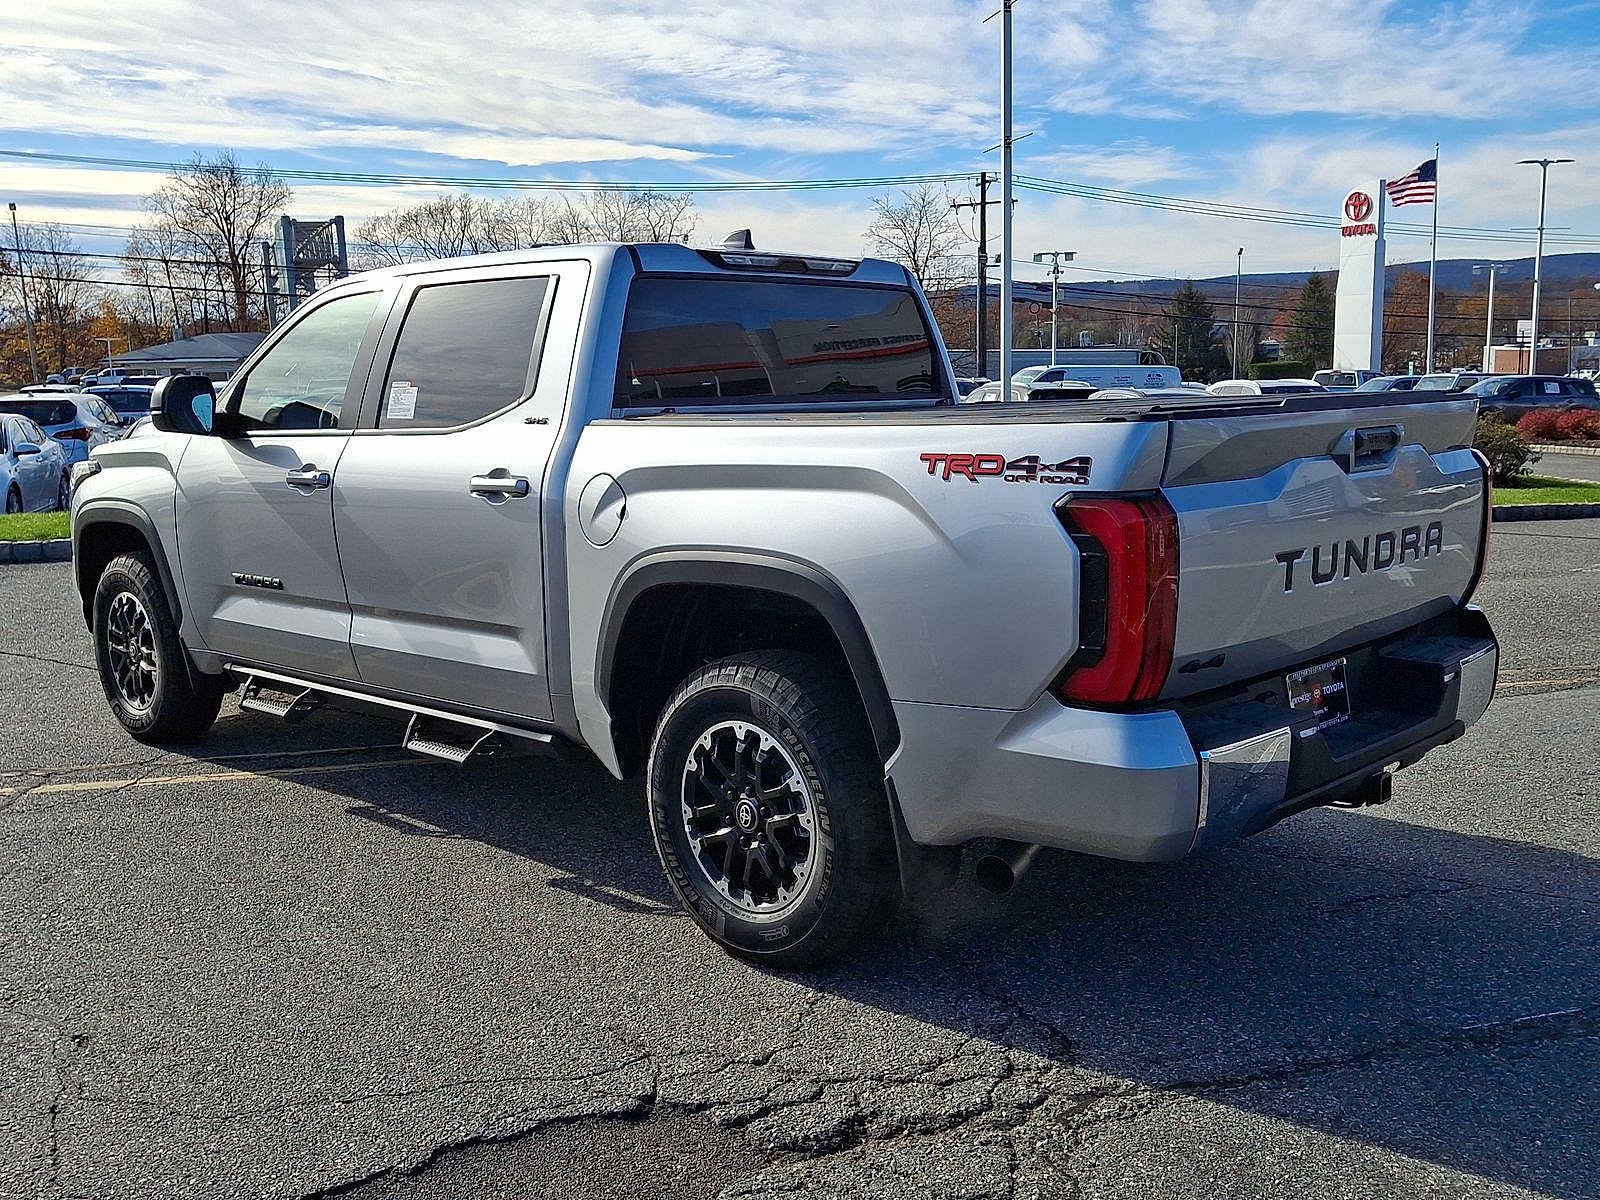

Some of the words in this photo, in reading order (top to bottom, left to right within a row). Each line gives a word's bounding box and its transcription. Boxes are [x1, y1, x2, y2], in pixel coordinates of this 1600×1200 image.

[1341, 224, 1377, 237] TOYOTA
[919, 453, 1006, 482] TRD
[1003, 475, 1037, 483] OFF
[1039, 475, 1089, 485] ROAD
[1274, 520, 1443, 593] TUNDRA
[231, 571, 284, 590] TUNDRA
[1322, 681, 1345, 695] TOYOTA
[782, 727, 831, 833] MICHELIN
